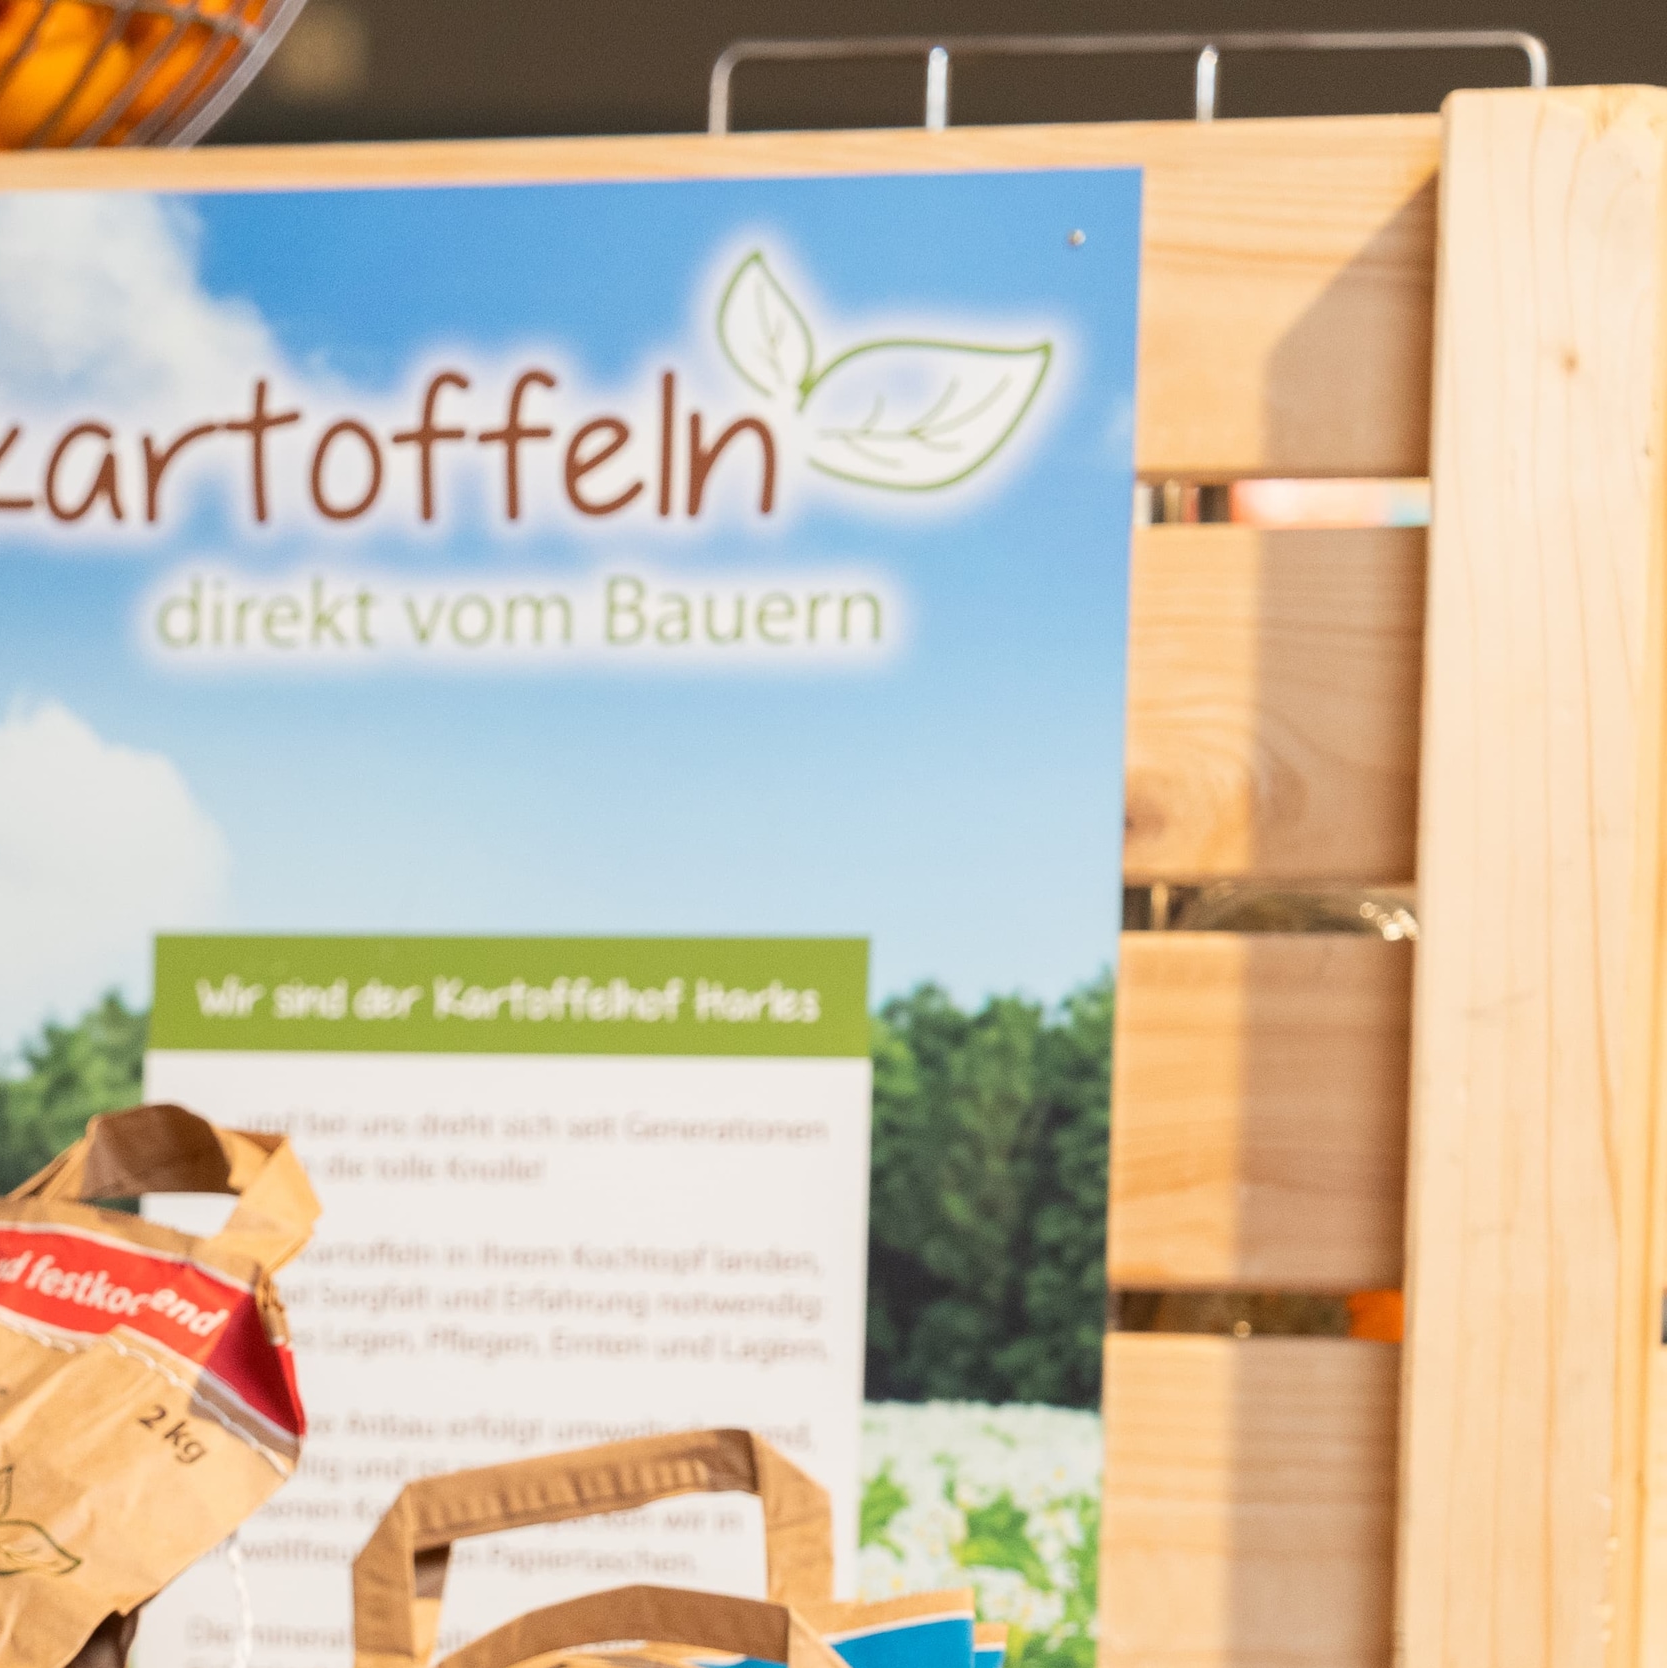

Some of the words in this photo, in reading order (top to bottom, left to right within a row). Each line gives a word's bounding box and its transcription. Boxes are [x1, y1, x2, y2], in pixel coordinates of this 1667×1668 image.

[155, 574, 376, 649] direkt
[406, 592, 574, 647] vom
[602, 576, 886, 649] Bauern
[194, 976, 263, 1019] Wir
[271, 978, 348, 1021] sind
[354, 980, 422, 1021] der
[432, 976, 683, 1023] Kartoffelhof
[693, 979, 822, 1025] Harles
[138, 1404, 166, 1431] 2
[164, 1420, 208, 1466] kg
